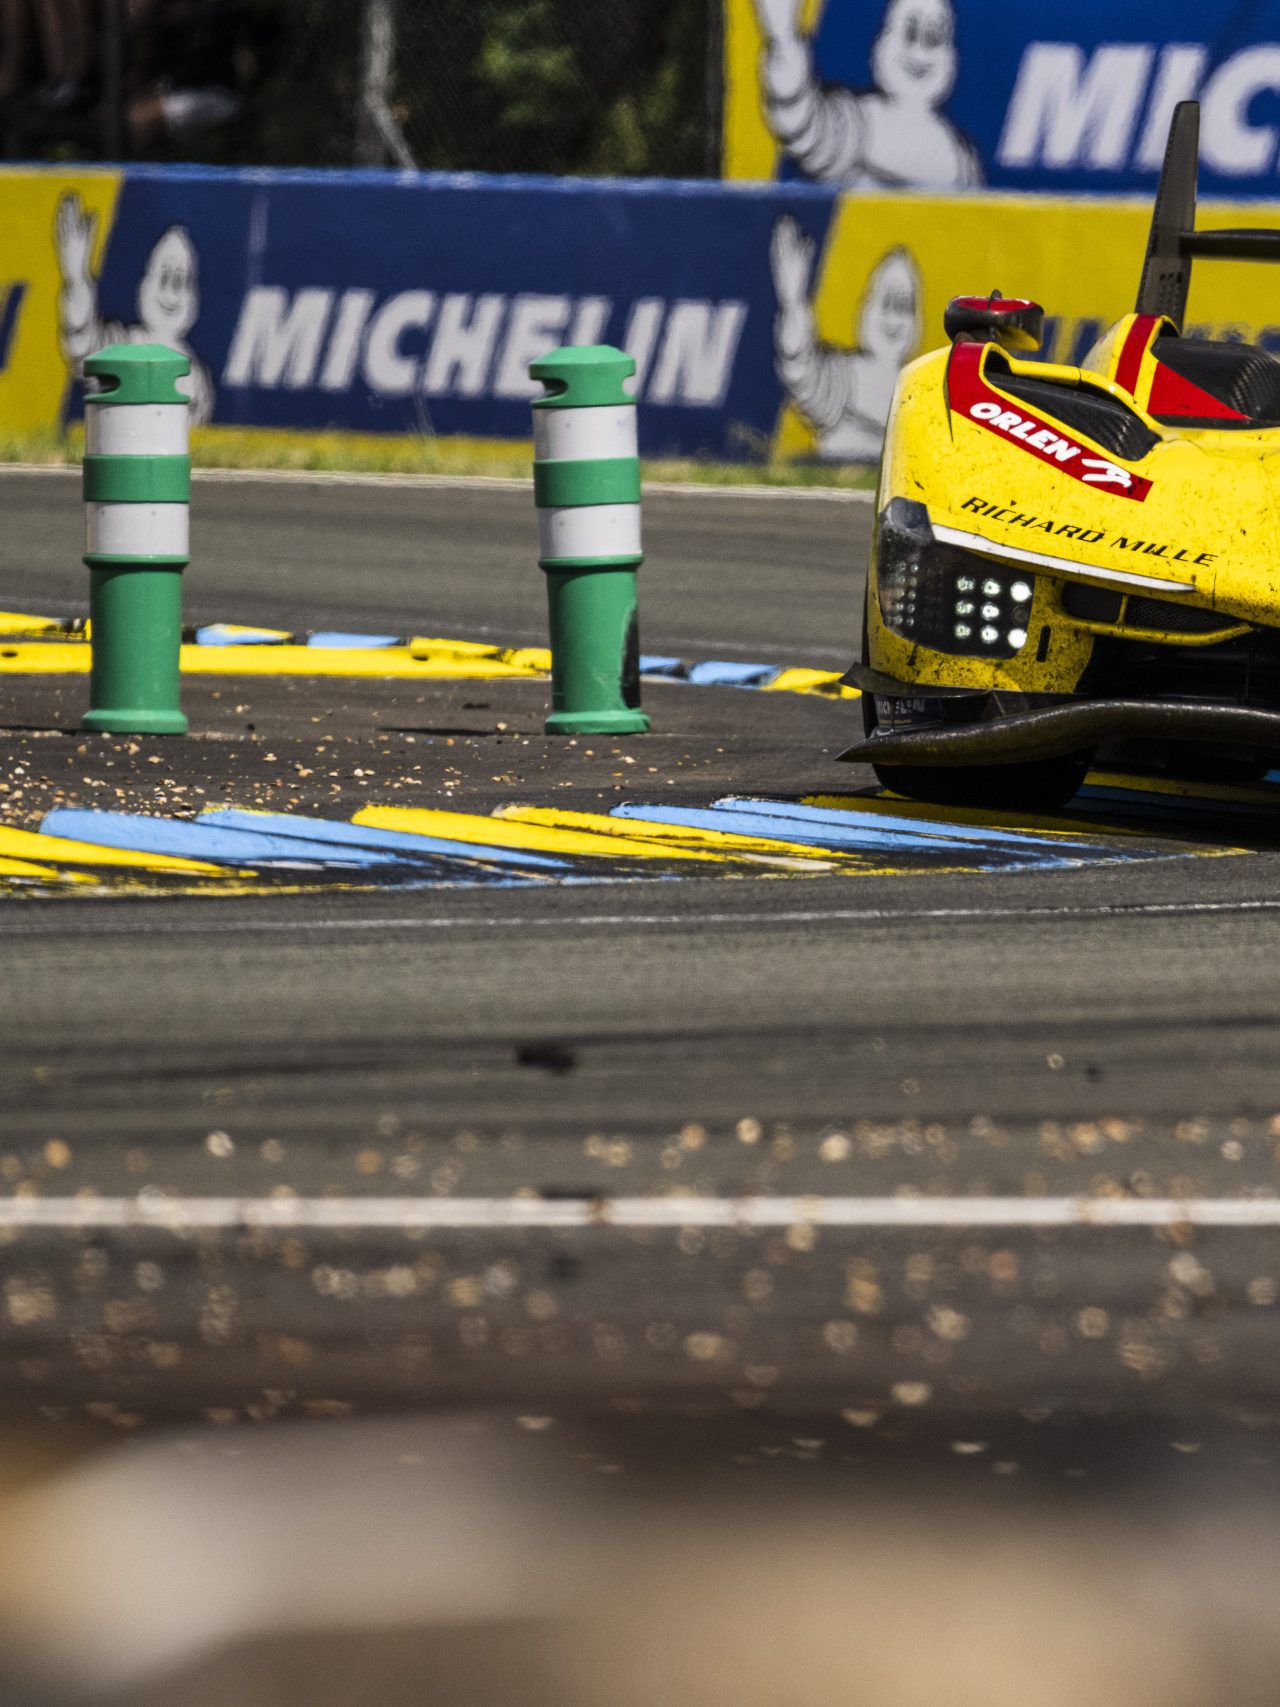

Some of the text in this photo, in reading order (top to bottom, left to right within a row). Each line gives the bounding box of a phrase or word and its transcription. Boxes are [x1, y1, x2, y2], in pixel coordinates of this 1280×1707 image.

[969, 402, 1081, 462] ORLEN
[961, 496, 1219, 567] RICHARD MILLE
